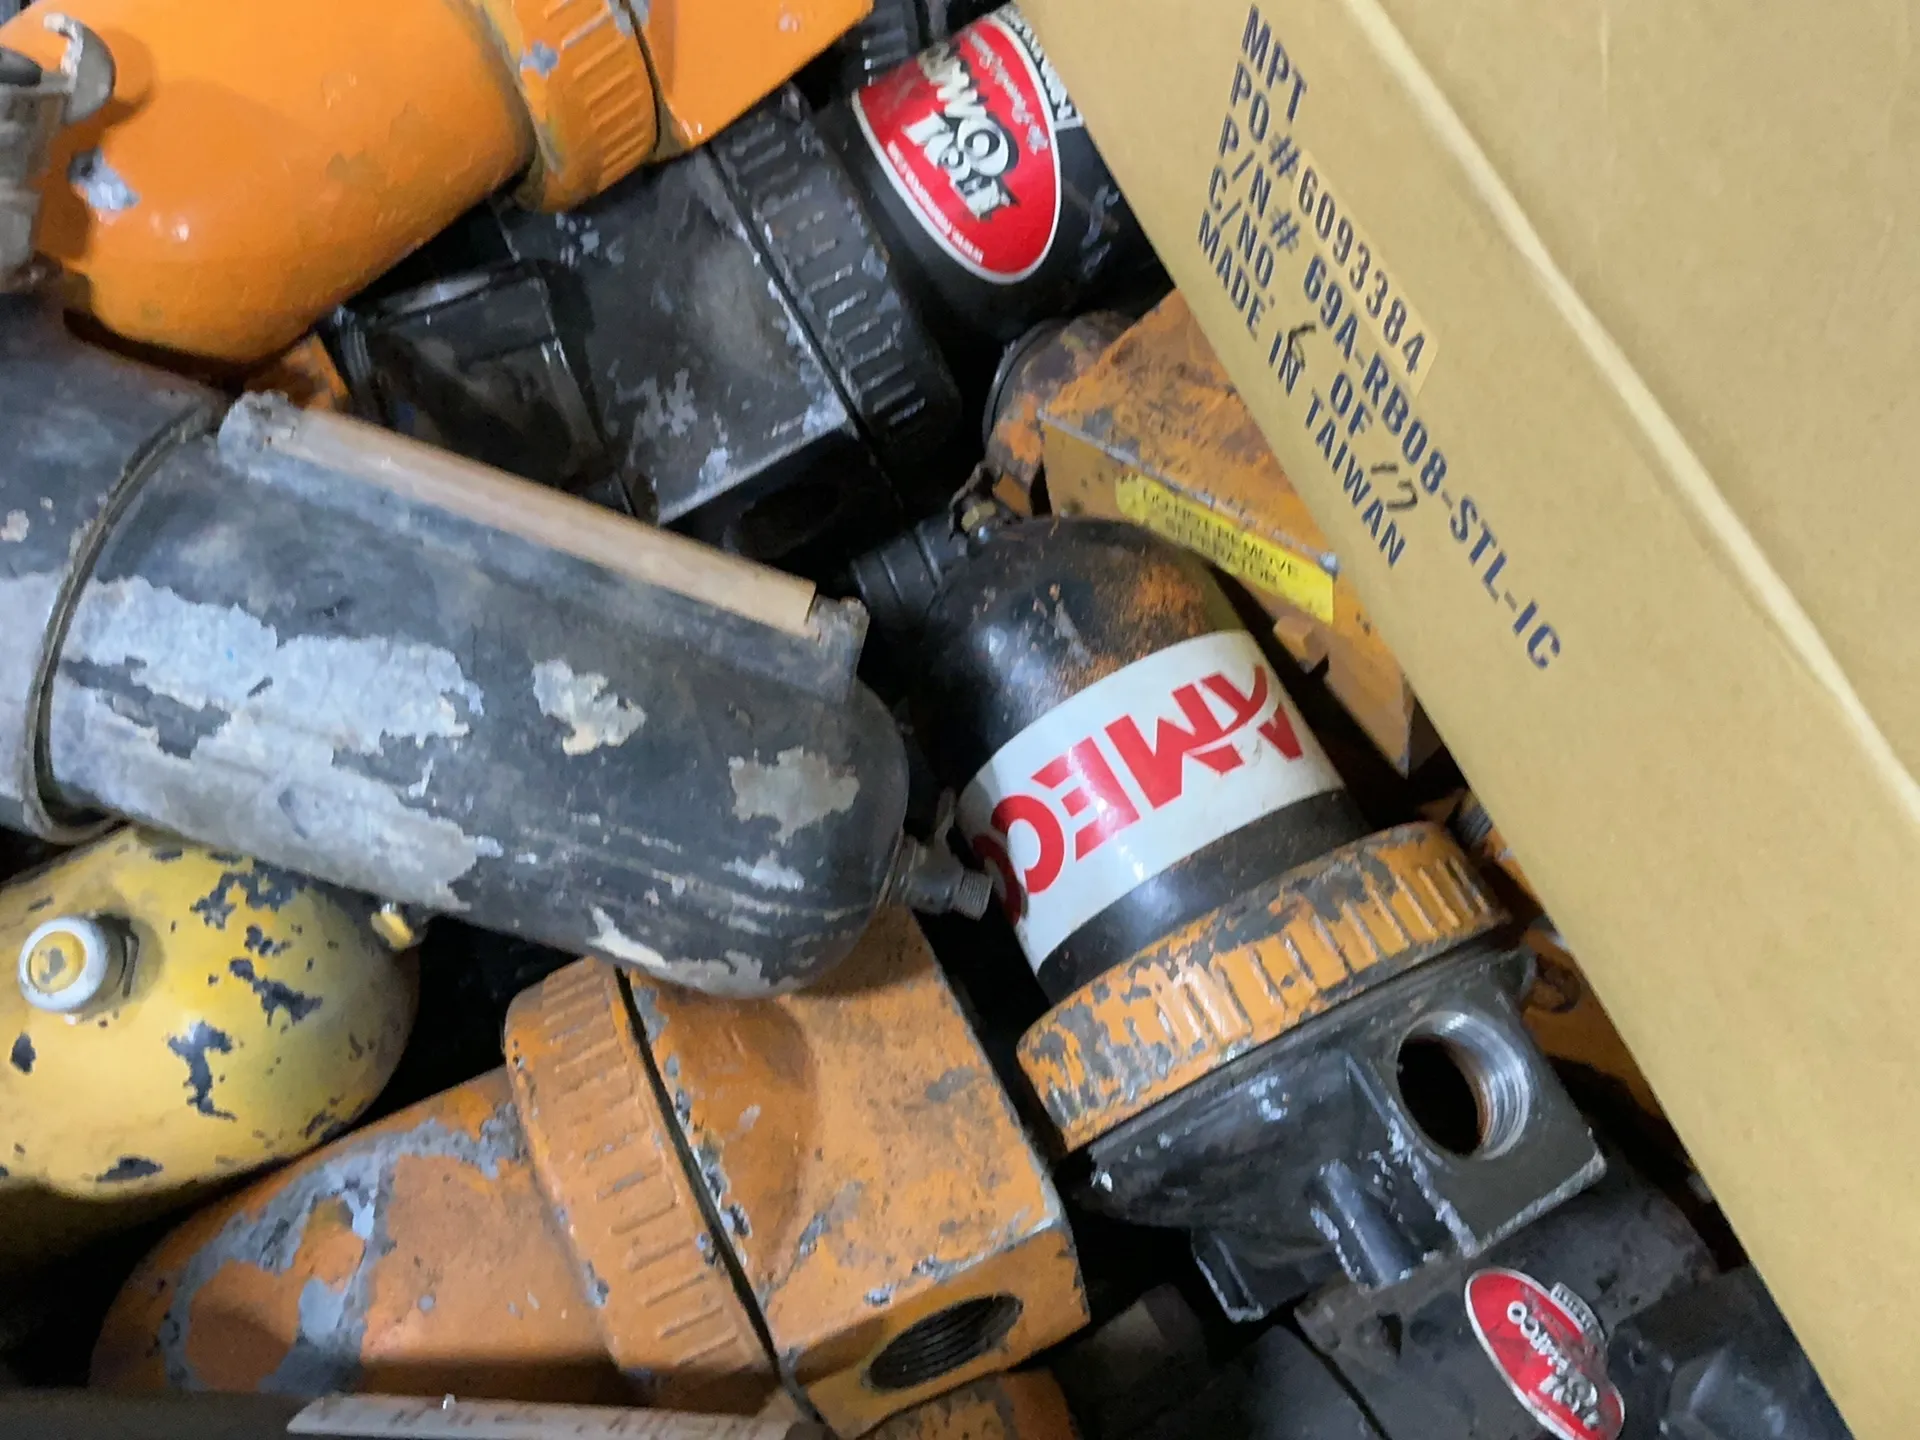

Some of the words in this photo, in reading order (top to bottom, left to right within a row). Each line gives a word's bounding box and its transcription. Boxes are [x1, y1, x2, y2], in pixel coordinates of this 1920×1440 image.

[1241, 2, 1308, 123] MPT
[1198, 209, 1267, 342] MADE
[1268, 329, 1302, 398] IN
[1304, 388, 1406, 568] TAIWAN
[1208, 163, 1276, 309] C/NO.
[1330, 371, 1374, 439] OF
[1218, 112, 1300, 253] P/N#
[1303, 254, 1561, 669] 69A-RB08-STL-IC
